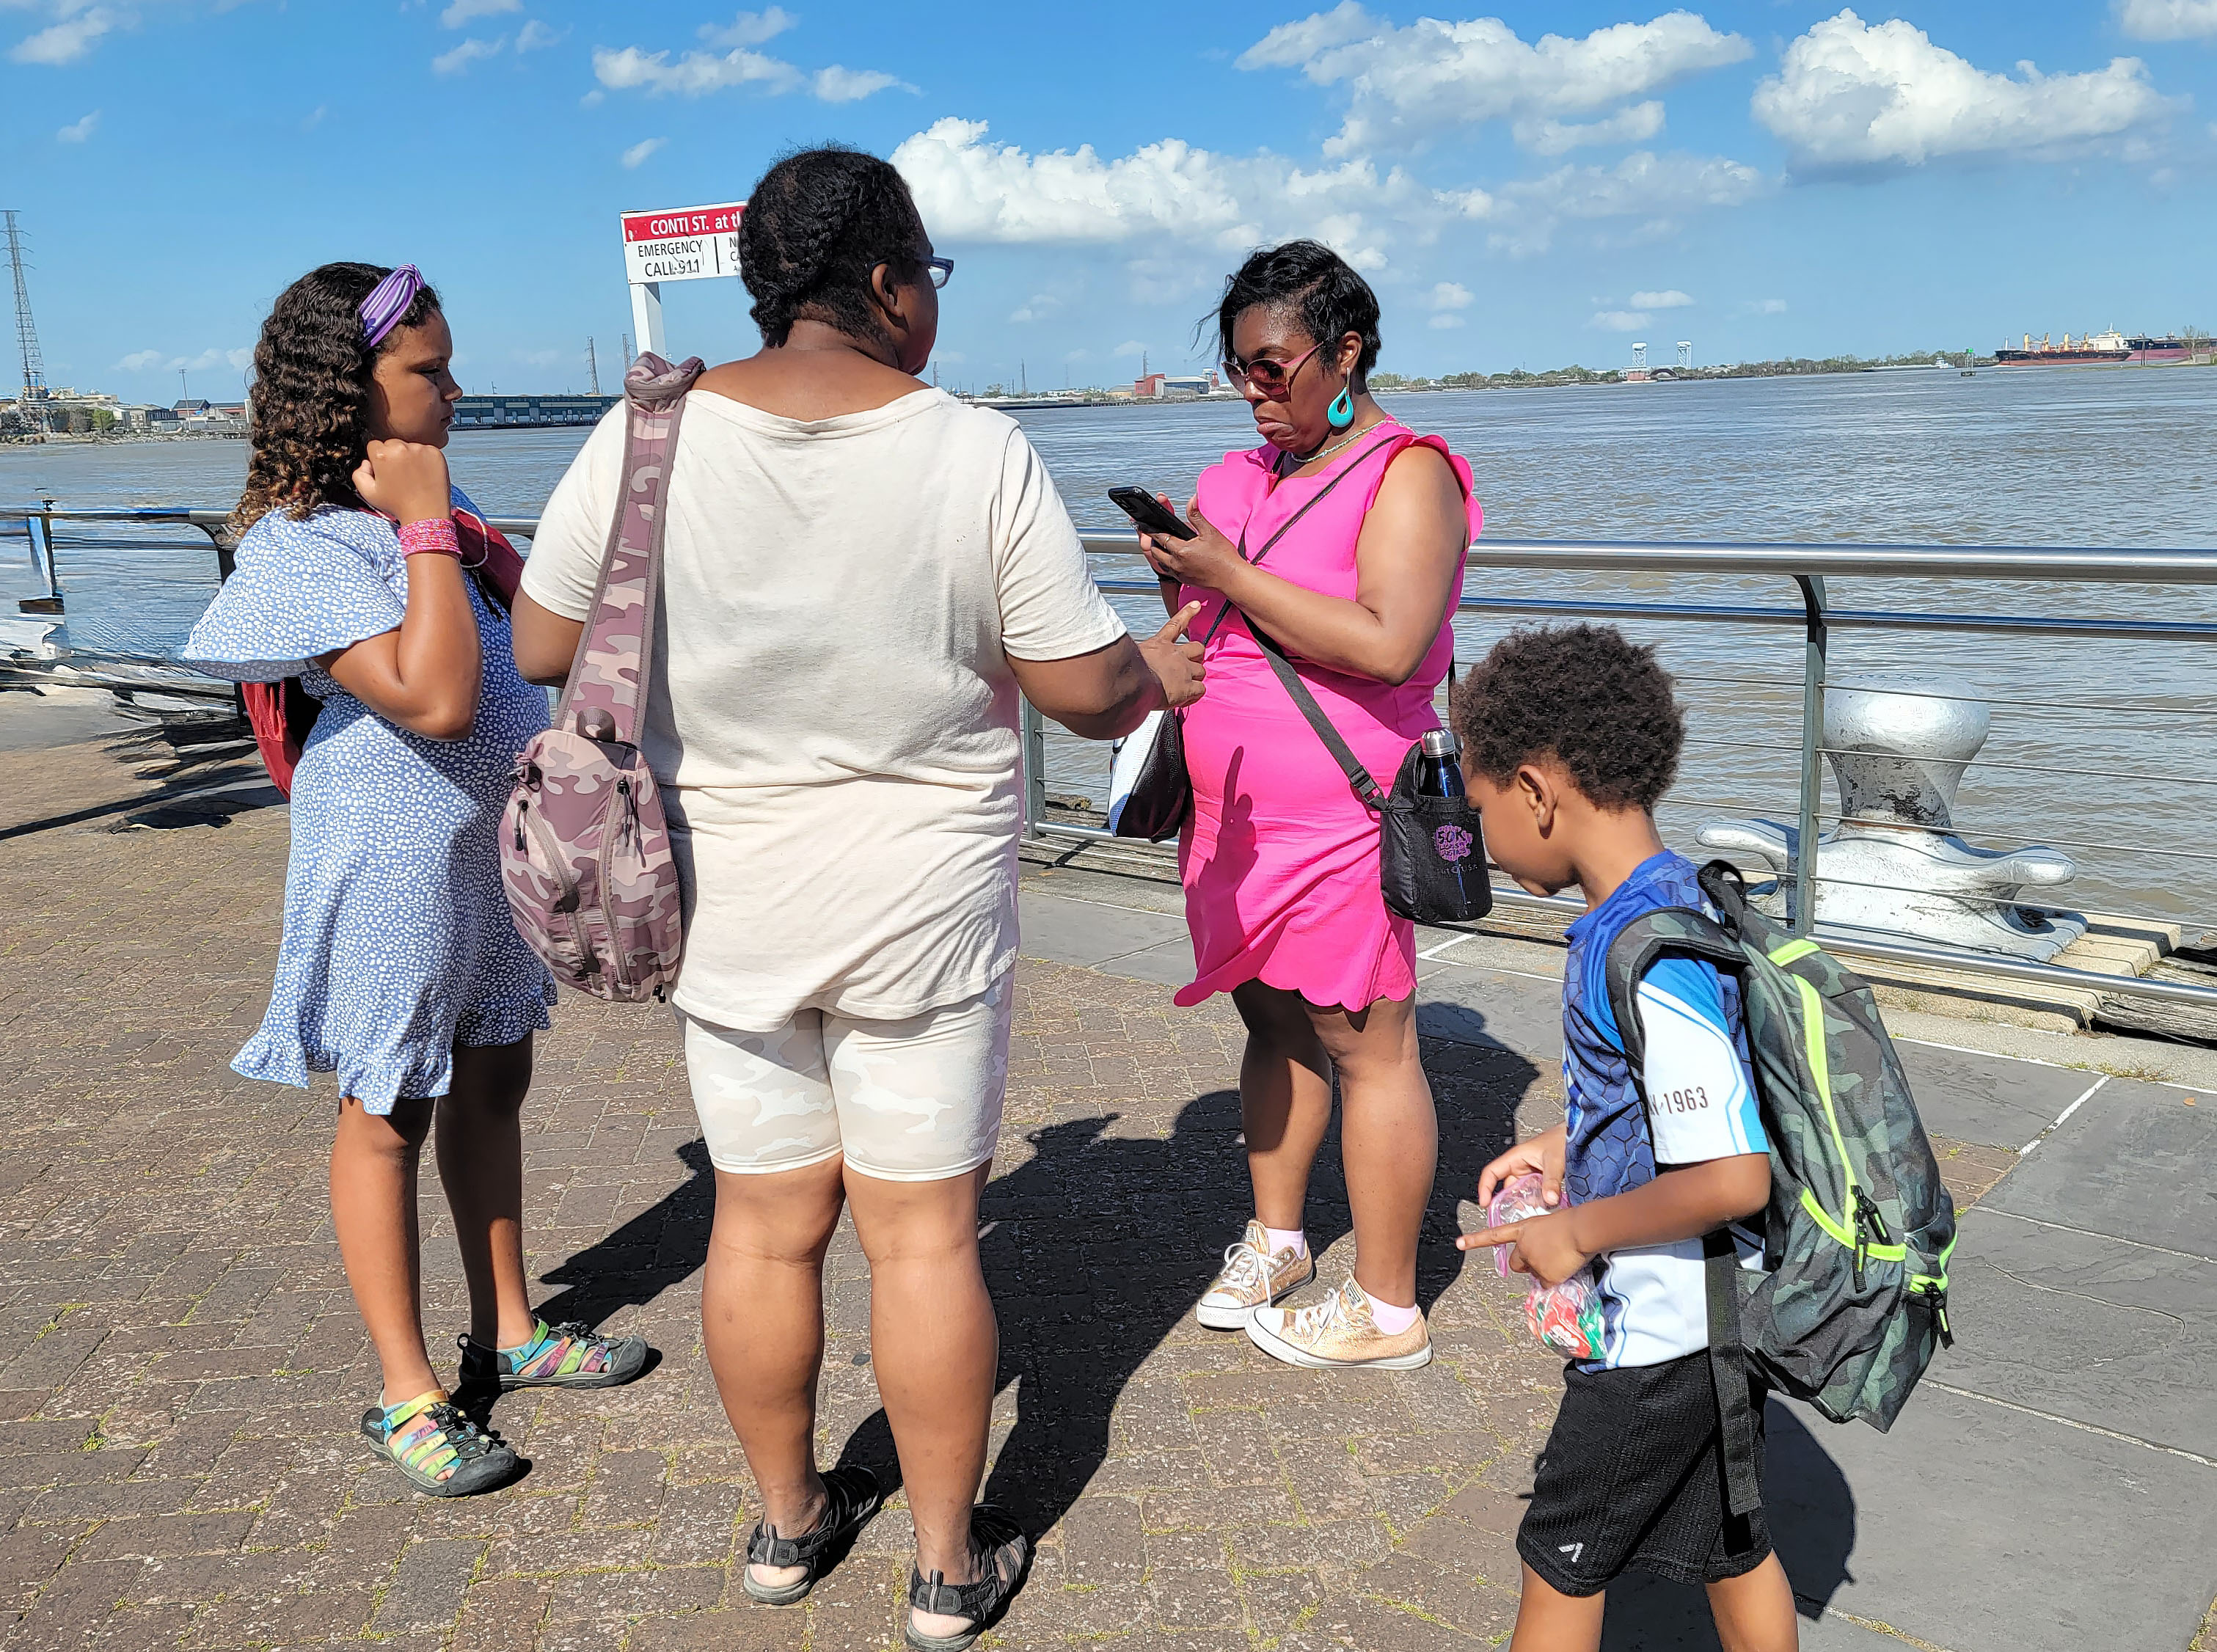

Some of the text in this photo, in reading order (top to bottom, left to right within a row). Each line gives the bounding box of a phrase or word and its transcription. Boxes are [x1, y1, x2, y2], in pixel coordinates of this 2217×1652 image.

[650, 216, 689, 235] CONTI
[692, 215, 709, 232] ST.
[715, 213, 729, 230] at
[638, 239, 703, 257] EMERGENCY
[645, 258, 700, 277] CALL 911
[1663, 1086, 1709, 1115] 1963
